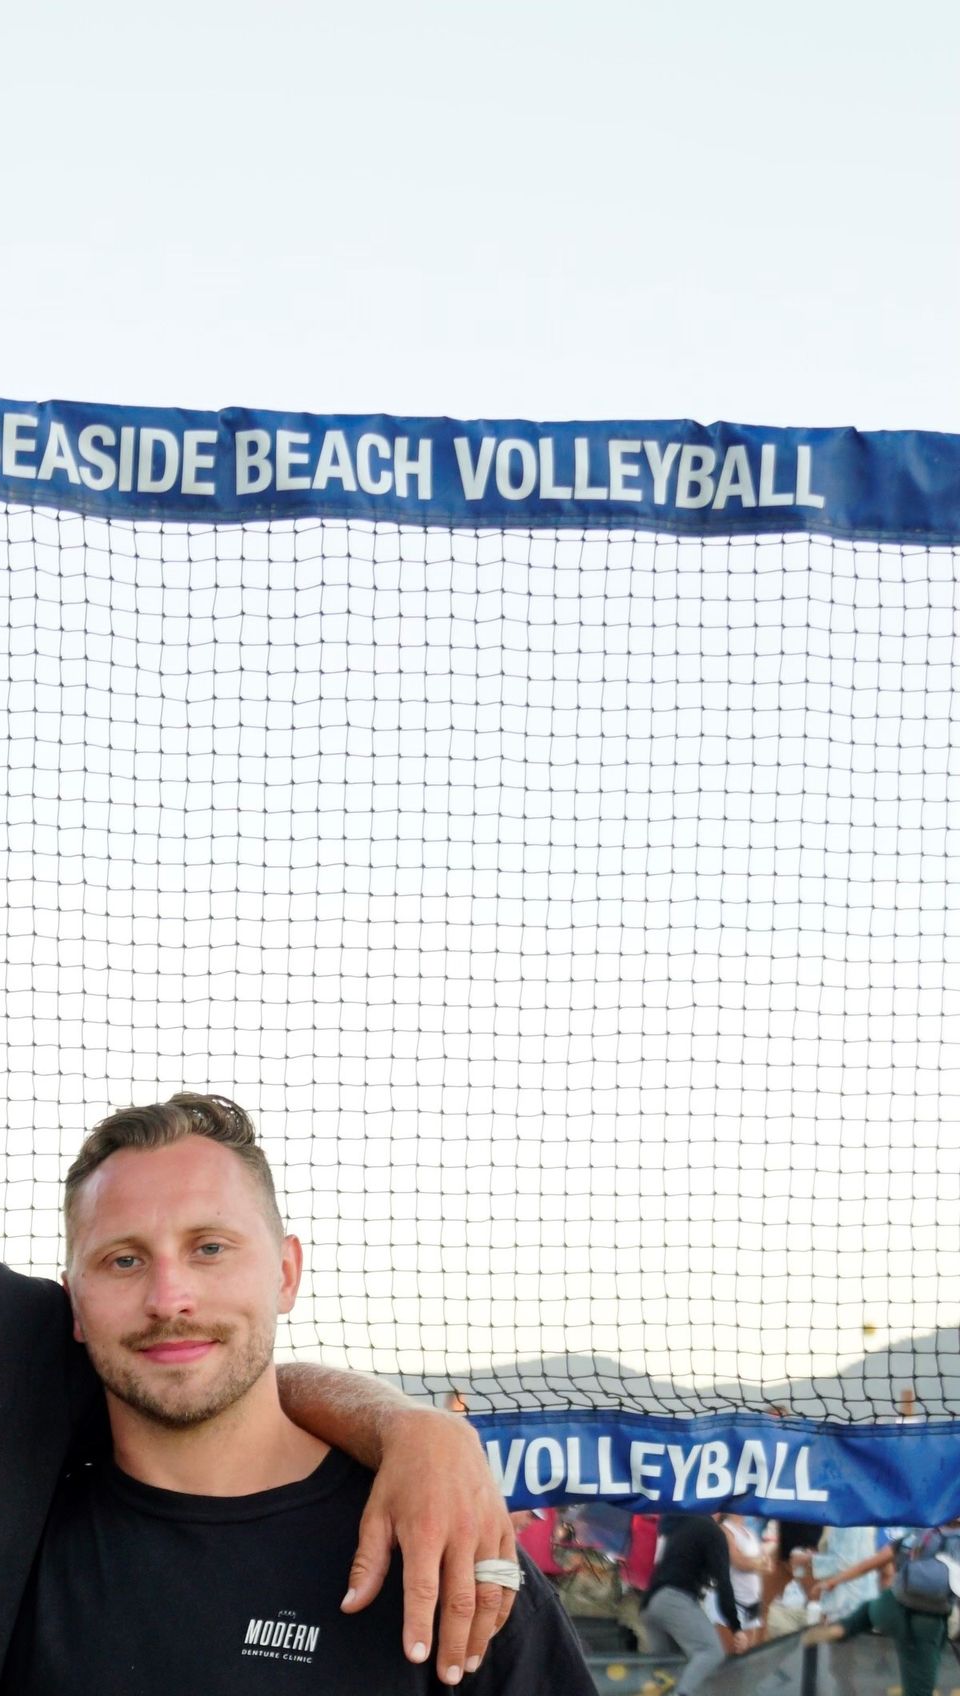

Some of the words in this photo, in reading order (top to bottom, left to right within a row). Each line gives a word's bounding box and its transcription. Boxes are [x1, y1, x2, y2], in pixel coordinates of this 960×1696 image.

[235, 429, 432, 496] BEACH
[453, 436, 825, 509] VOLLEYBALL
[486, 1435, 829, 1502] VOLLEYBALL
[241, 1648, 280, 1659] DENTURE
[282, 1653, 312, 1664] CLINIC
[244, 1618, 320, 1652] MODERN
